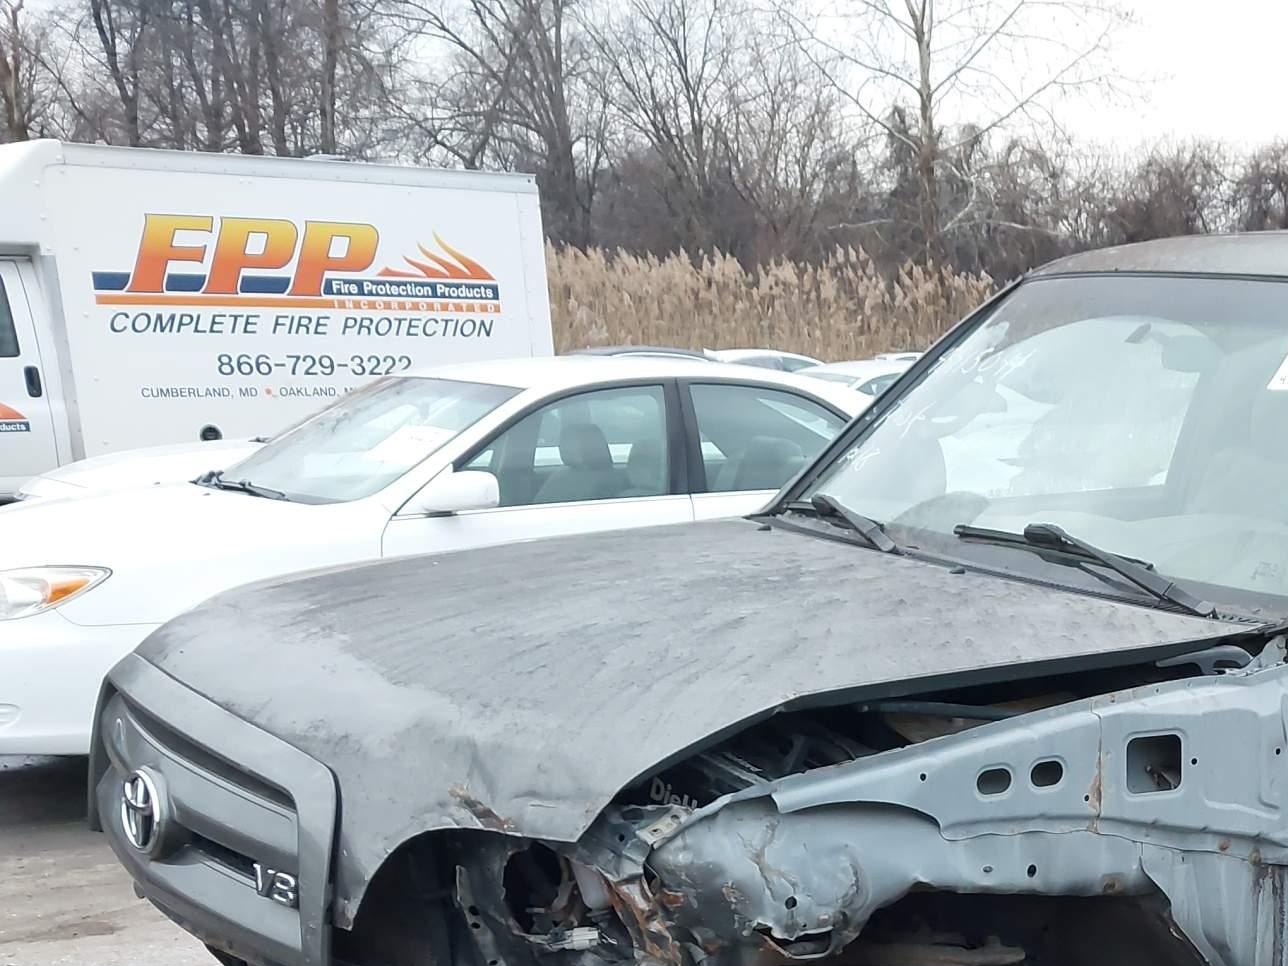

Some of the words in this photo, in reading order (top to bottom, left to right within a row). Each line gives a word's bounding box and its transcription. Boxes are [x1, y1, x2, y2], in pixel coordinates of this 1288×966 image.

[124, 212, 380, 297] FPP
[331, 280, 358, 294] Fire
[363, 281, 432, 297] Protection
[436, 283, 494, 298] Products
[333, 300, 496, 313] INCORPORATED
[109, 311, 261, 334] COMPLETE
[271, 314, 331, 335] FIRE
[341, 316, 495, 338] PROTECTION
[216, 353, 412, 377] 866-729-3222
[140, 386, 235, 399] CUMBERLAND,
[239, 387, 259, 398] MD
